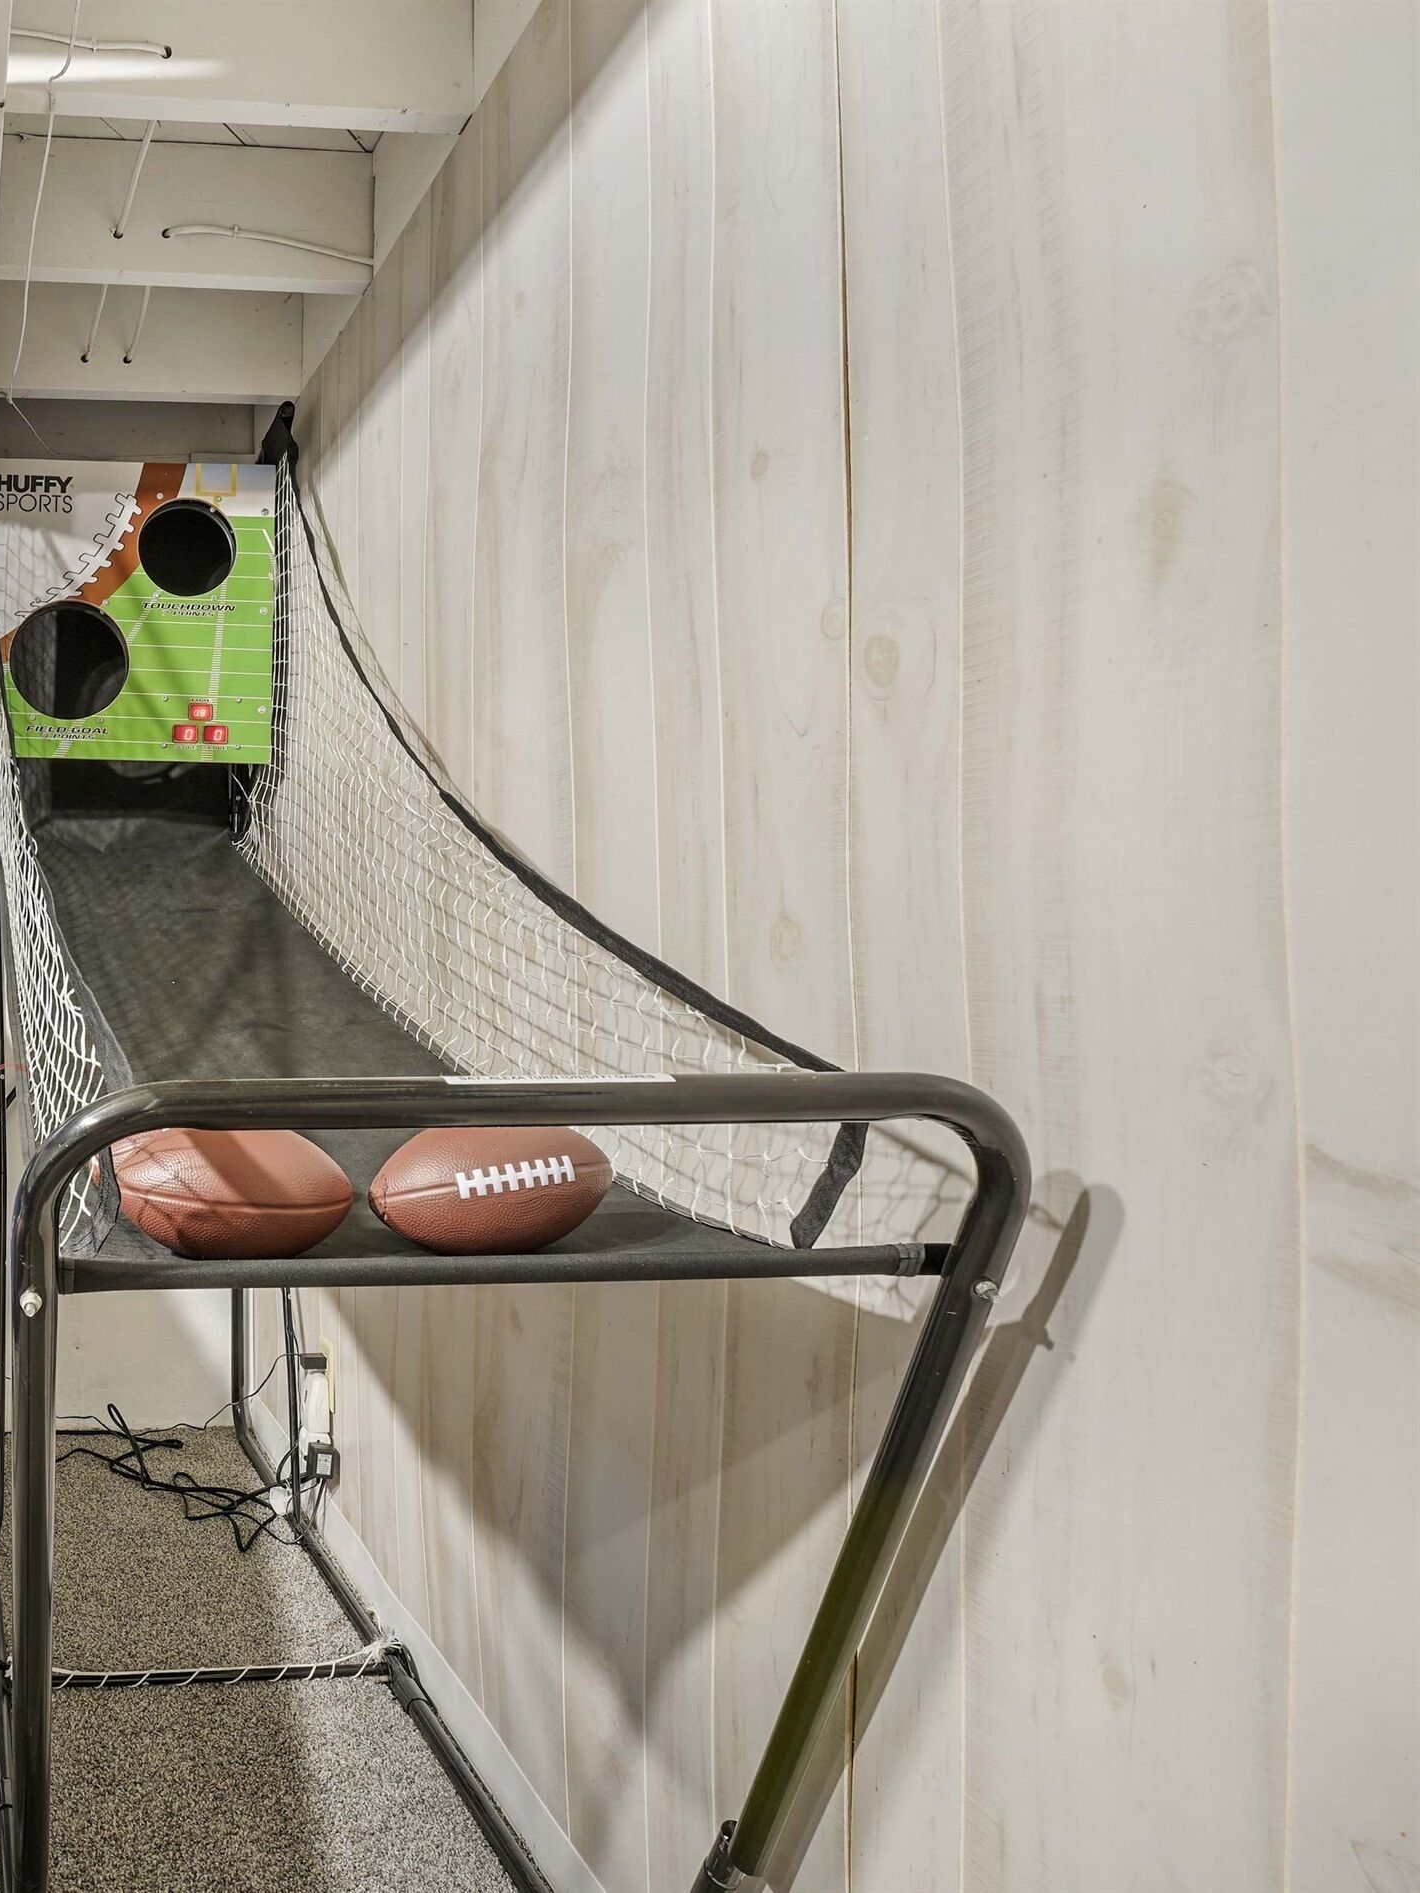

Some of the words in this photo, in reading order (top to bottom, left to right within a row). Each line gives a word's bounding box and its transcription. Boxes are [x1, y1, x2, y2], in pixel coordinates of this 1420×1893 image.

[142, 602, 236, 611] TOUCHDOWN
[26, 725, 67, 733] FIELD
[70, 726, 110, 735] GOAL
